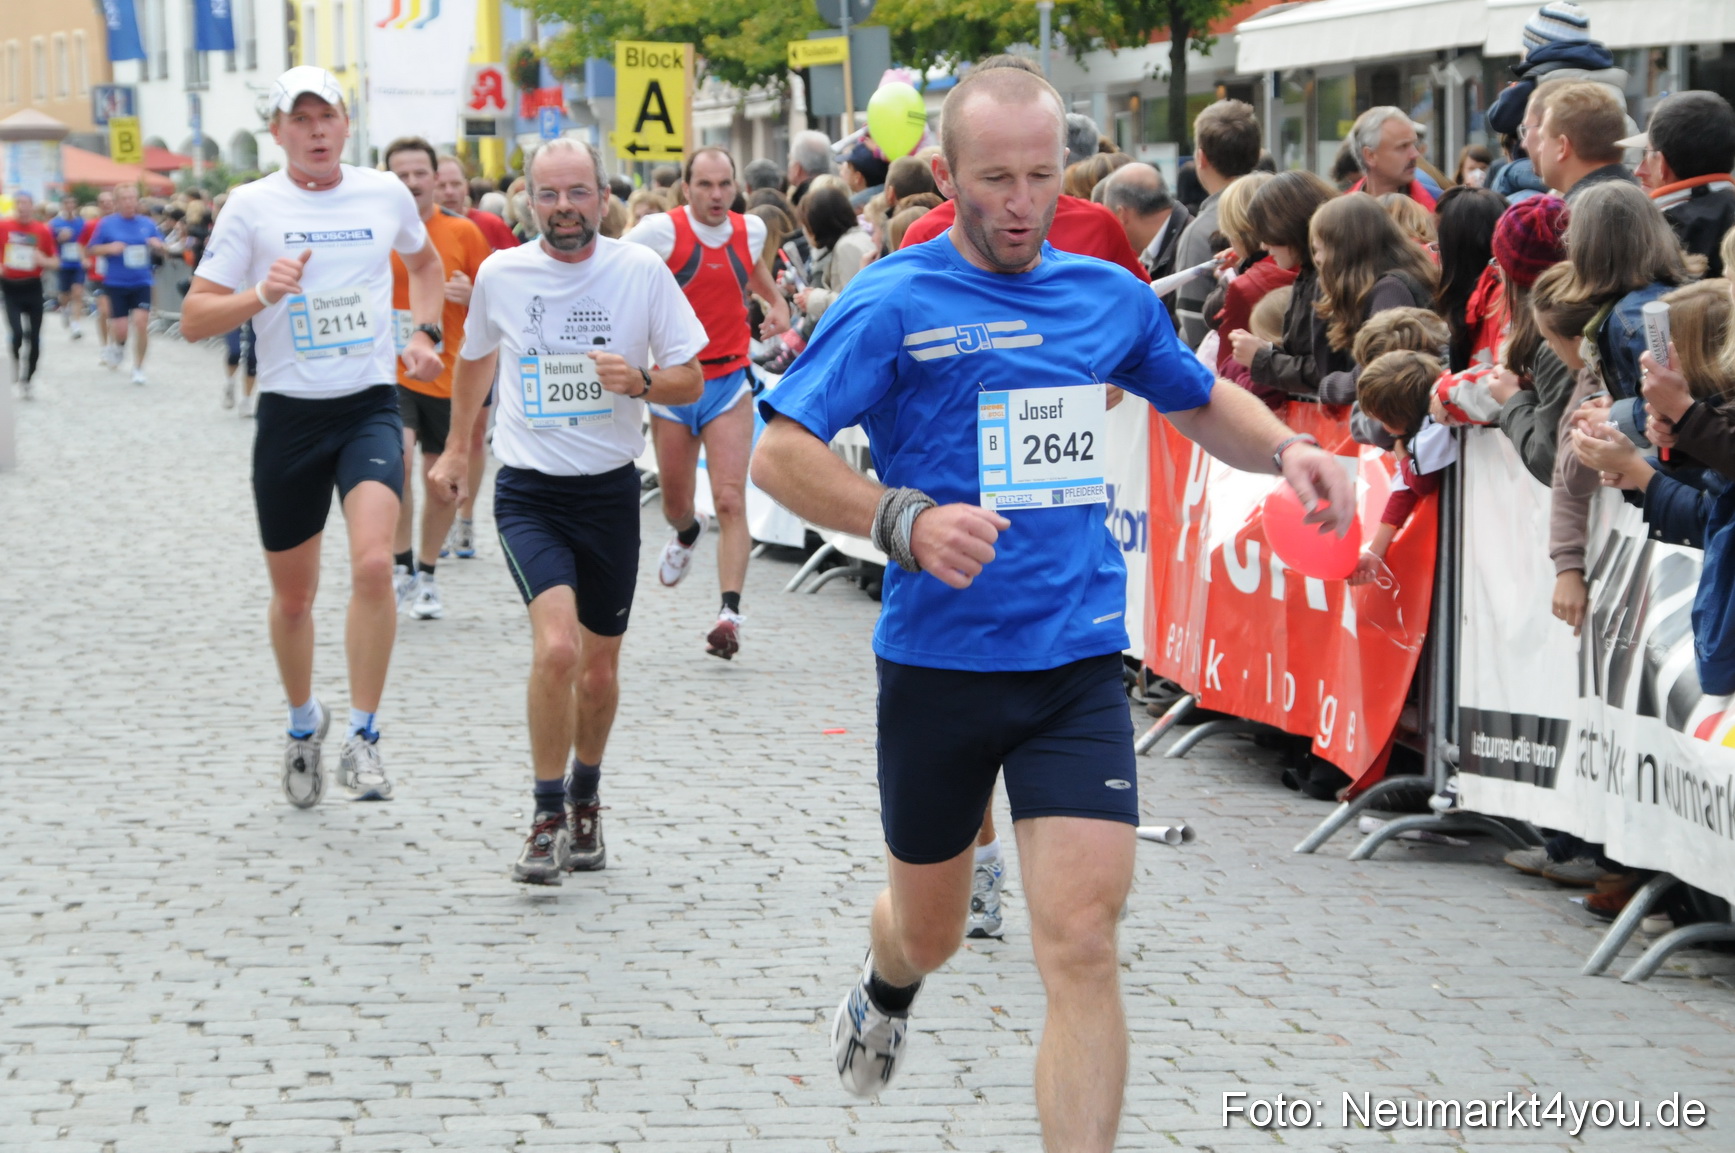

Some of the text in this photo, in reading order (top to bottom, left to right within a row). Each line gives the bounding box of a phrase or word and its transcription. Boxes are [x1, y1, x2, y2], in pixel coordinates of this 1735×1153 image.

[625, 47, 684, 69] Block
[633, 79, 675, 134] A
[118, 131, 134, 153] B
[312, 292, 361, 311] Christoph
[318, 311, 368, 335] 2114
[564, 324, 611, 333] 21.09.2008
[544, 362, 583, 375] Helmut
[547, 381, 602, 402] 2089
[1019, 398, 1064, 421] Josef
[989, 435, 998, 451] B
[1023, 431, 1094, 465] 2642
[1064, 485, 1105, 499] PFLEIDERER
